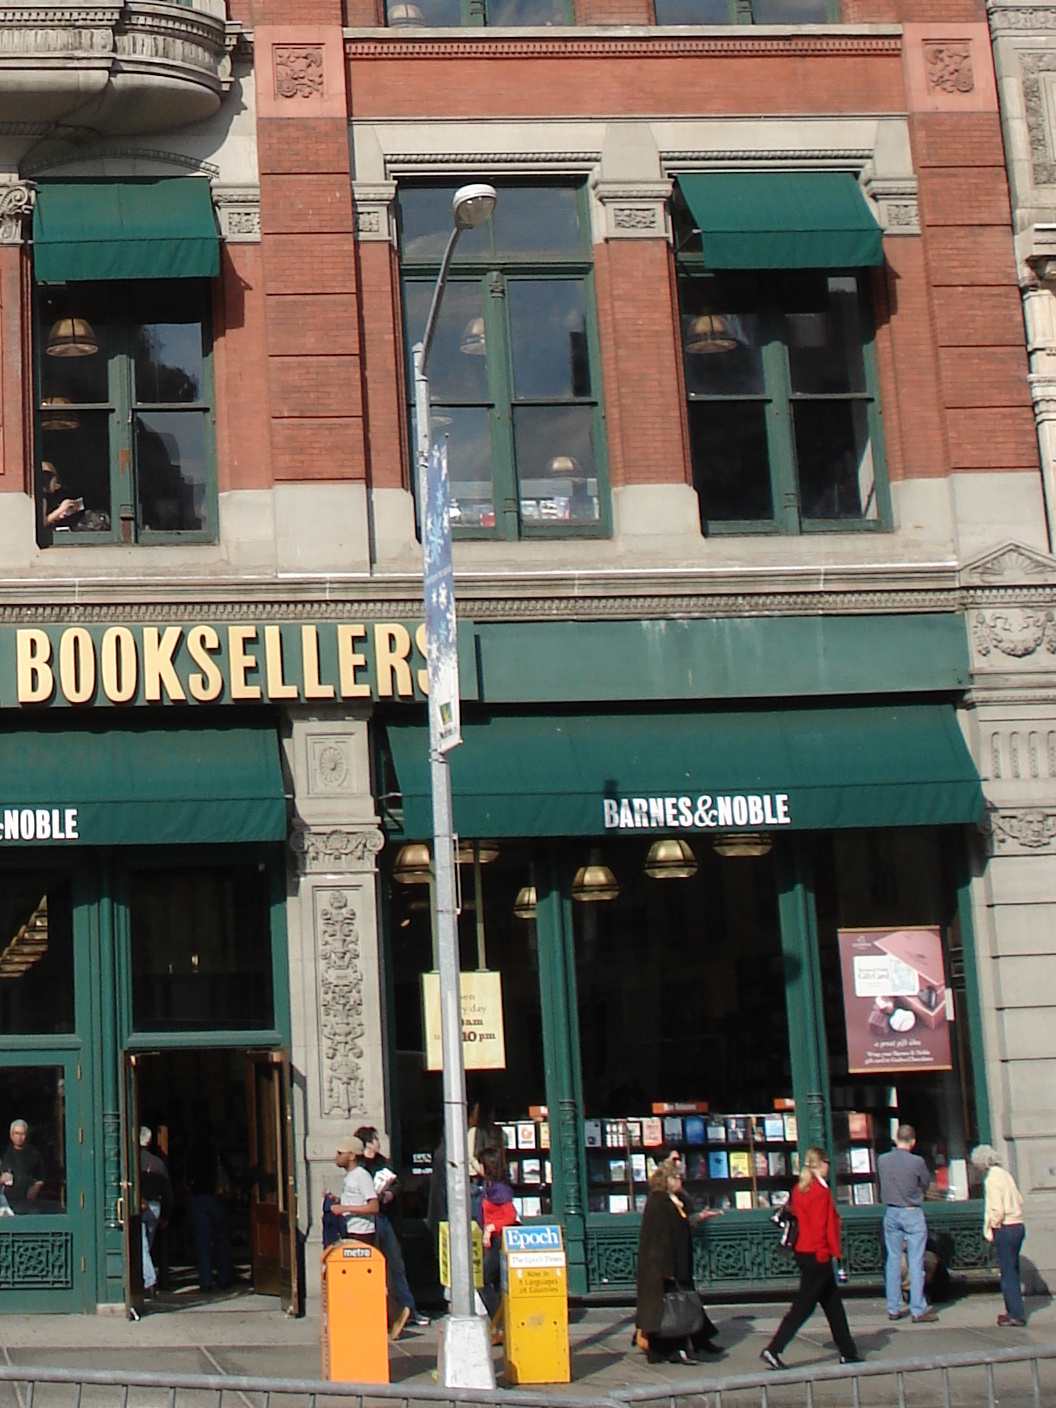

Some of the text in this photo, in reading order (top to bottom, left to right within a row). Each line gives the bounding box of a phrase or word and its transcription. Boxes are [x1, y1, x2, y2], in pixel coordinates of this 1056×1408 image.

[603, 794, 792, 829] BARNES&NOBLE
[507, 1226, 559, 1249] Epoch
[344, 1248, 371, 1257] metro
